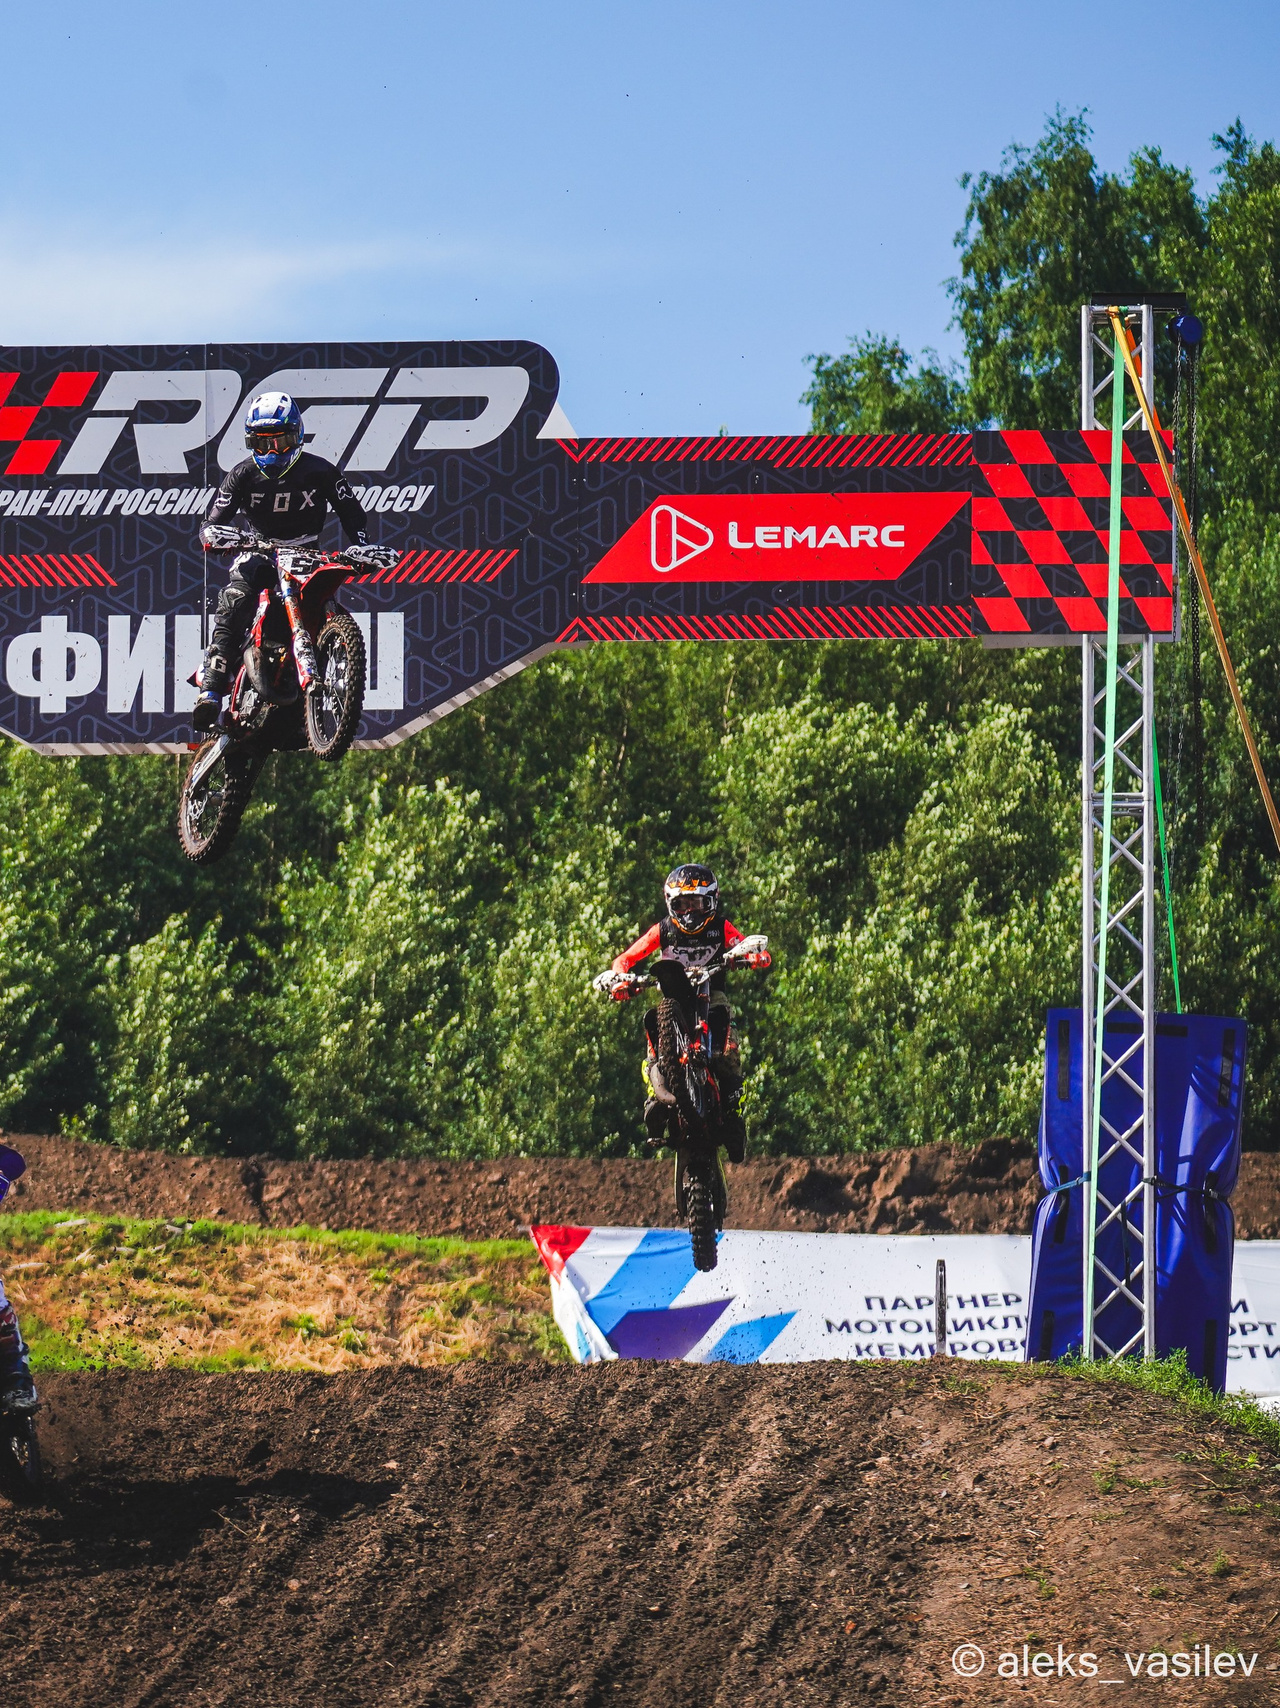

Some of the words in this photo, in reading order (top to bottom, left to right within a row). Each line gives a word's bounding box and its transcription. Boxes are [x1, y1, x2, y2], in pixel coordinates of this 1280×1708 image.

[57, 365, 530, 474] RGP
[102, 487, 216, 516] РОССИИ
[327, 485, 435, 513] РОССУ
[250, 489, 318, 513] FOX
[727, 520, 906, 550] LEMARC
[6, 611, 405, 714] ФИНШ
[825, 1314, 1028, 1335] МОТОЦИКЛ
[855, 1338, 1026, 1357] КЕМРОВ
